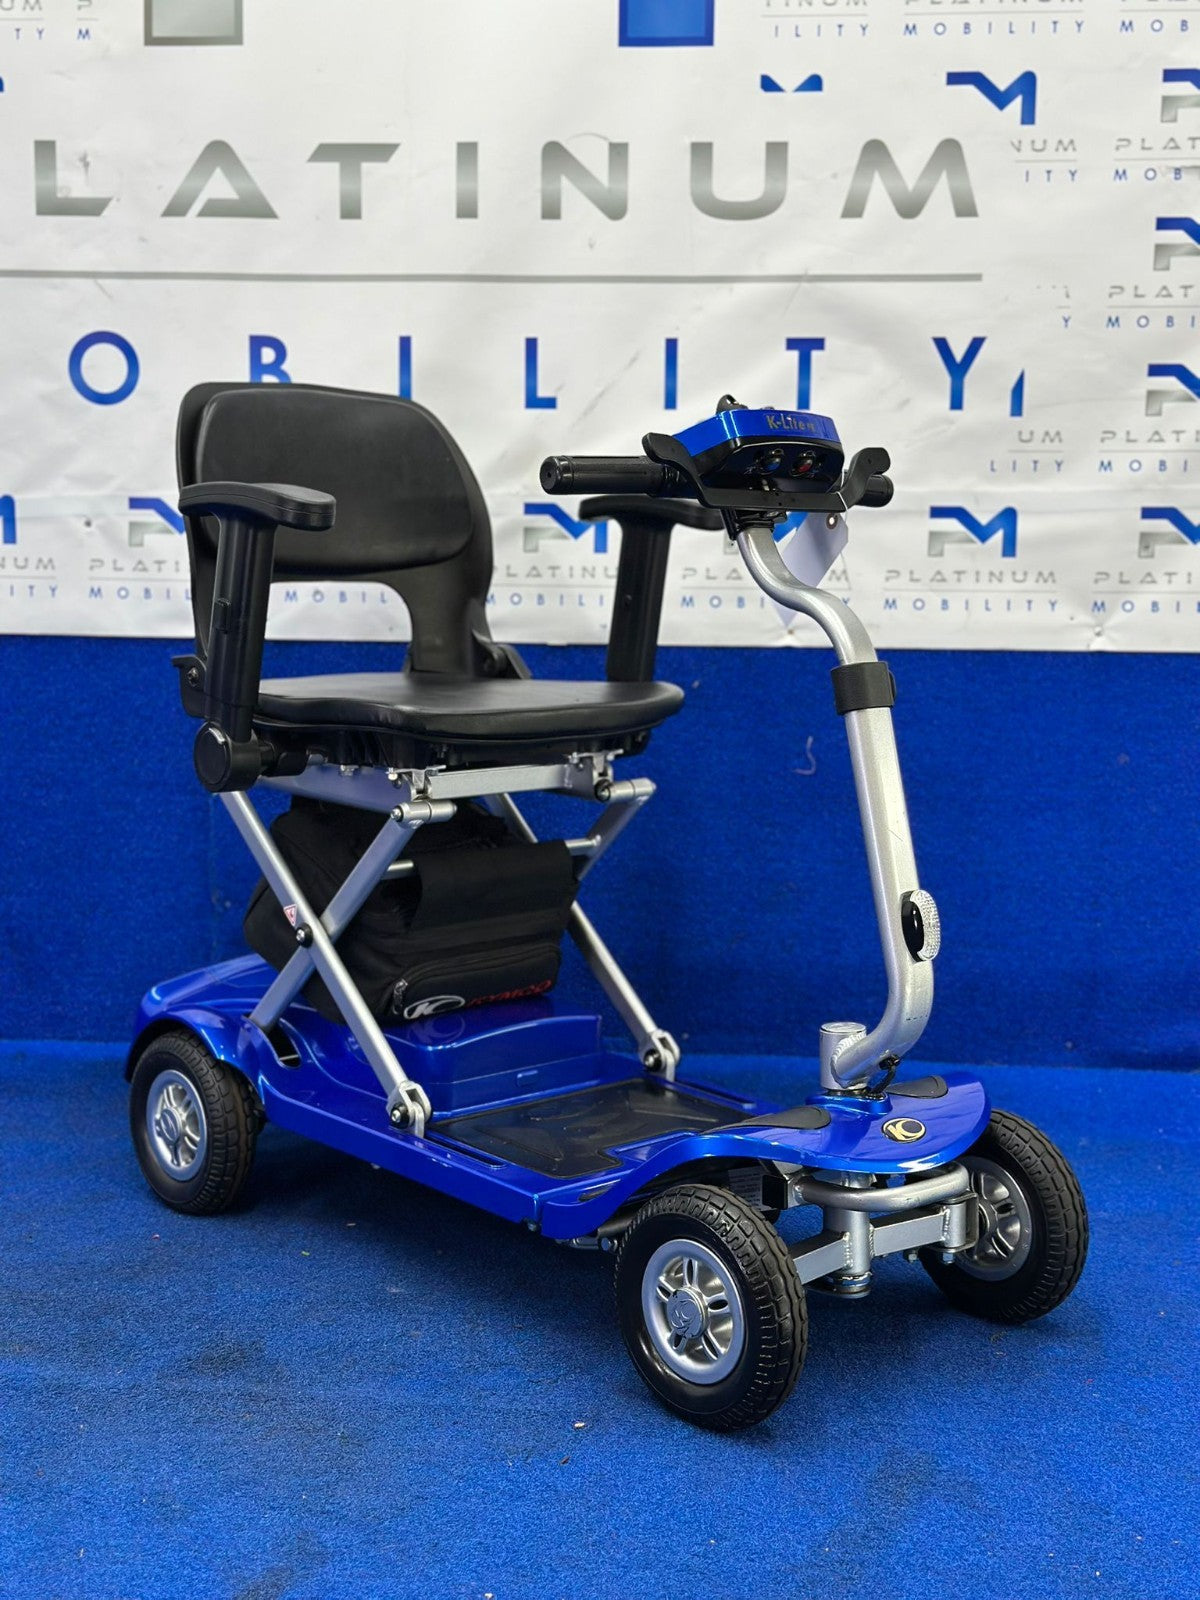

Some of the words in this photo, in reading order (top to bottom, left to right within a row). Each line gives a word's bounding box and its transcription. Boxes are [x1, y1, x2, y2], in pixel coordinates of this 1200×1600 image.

[904, 20, 1084, 36] MOBILITY
[494, 565, 619, 579] LATINU
[885, 569, 1057, 584] PLATINUM
[883, 598, 1058, 612] MOBILITY
